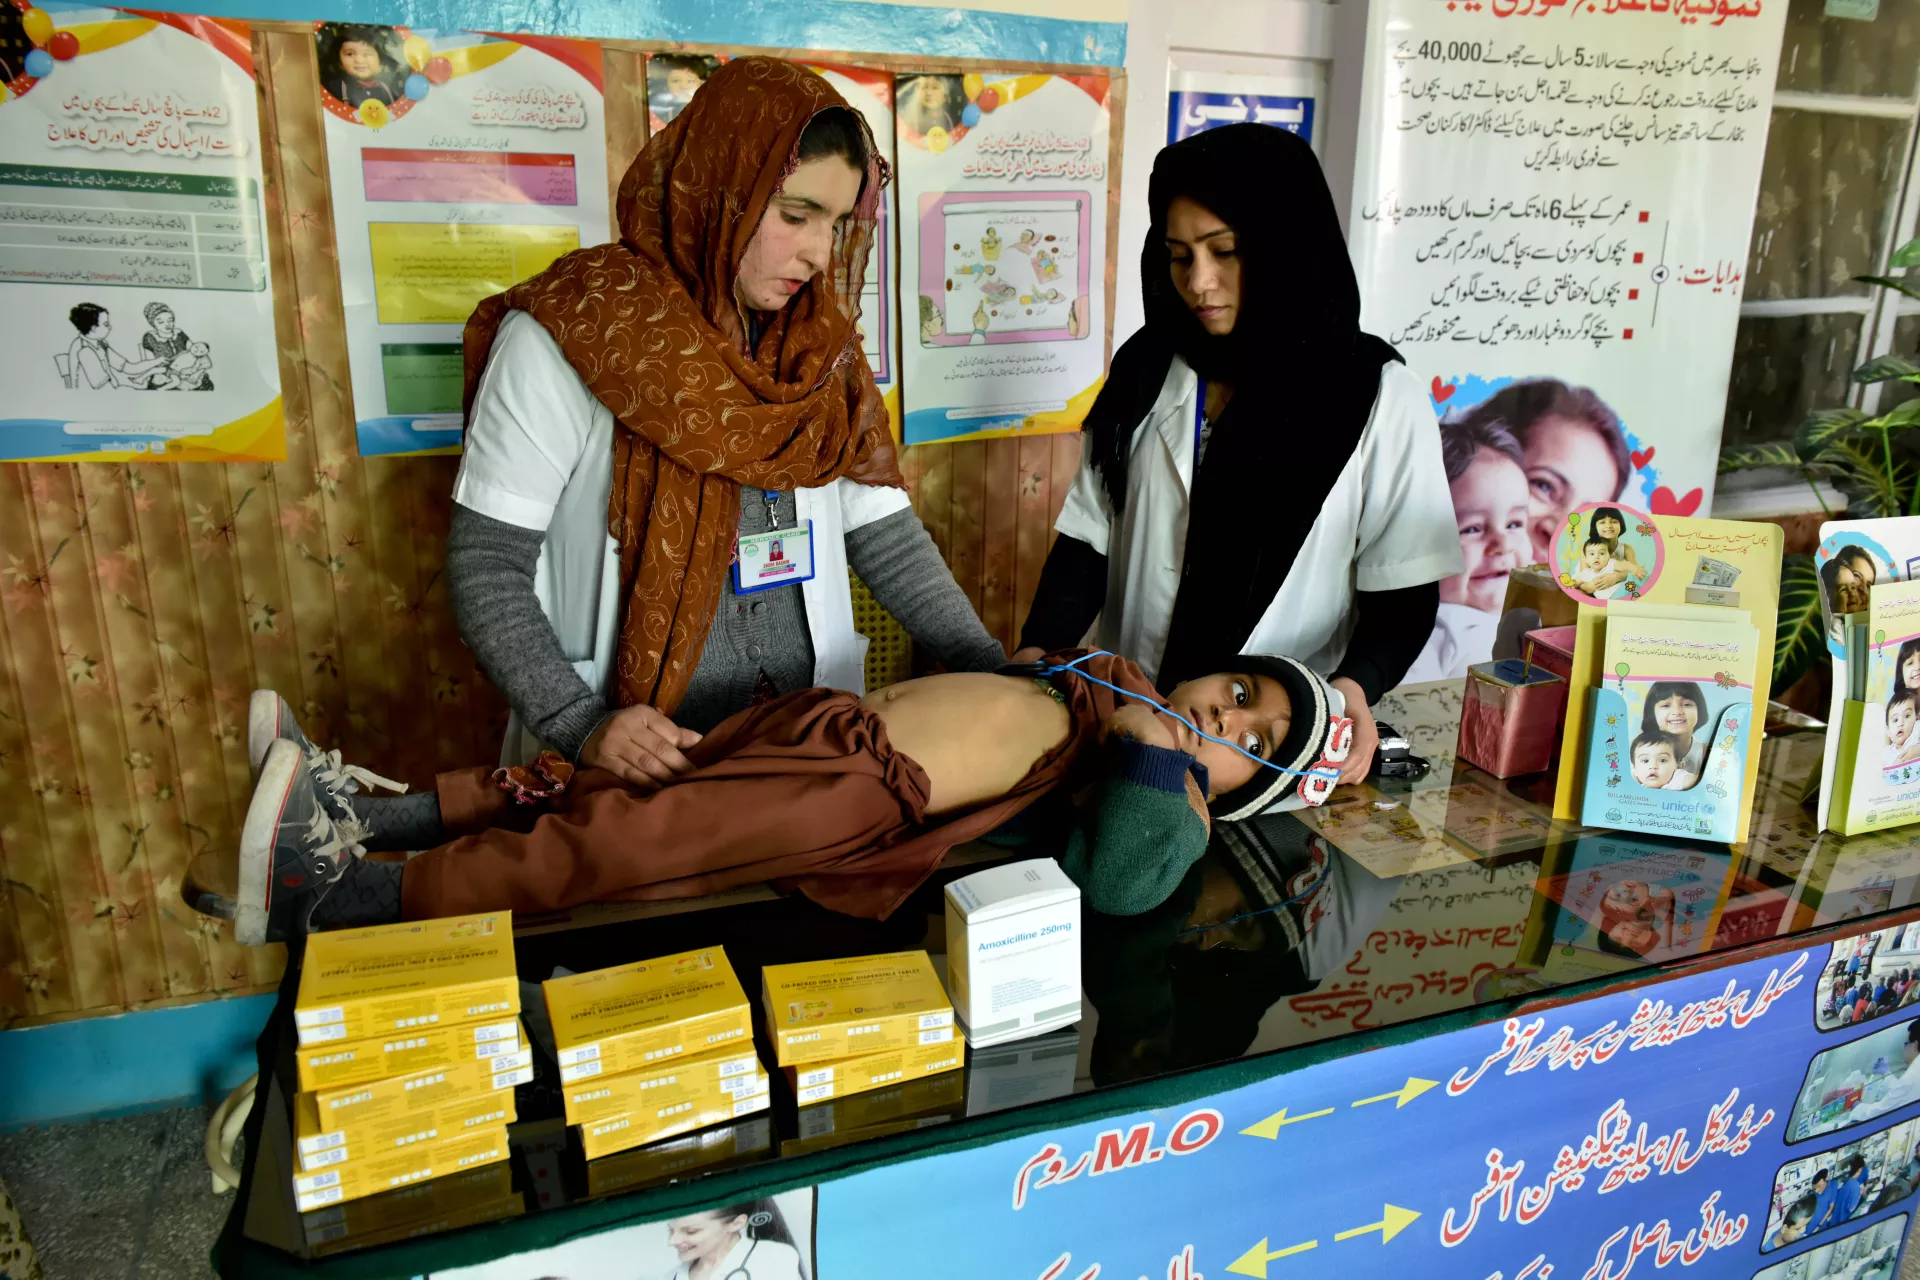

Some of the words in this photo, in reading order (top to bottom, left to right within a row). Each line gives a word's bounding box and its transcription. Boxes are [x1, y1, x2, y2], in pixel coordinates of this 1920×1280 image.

[1418, 40, 1482, 64] 40,000
[1482, 38, 1526, 68] چھوٹے
[1521, 54, 1544, 65] سے
[1545, 44, 1572, 69] سال
[1574, 47, 1586, 67] 5
[1584, 52, 1617, 69] سالانہ
[1655, 46, 1674, 73] کی
[1615, 59, 1636, 69] سے
[1636, 60, 1655, 75] وجہ
[1666, 51, 1696, 77] نمونیہ
[1692, 55, 1714, 75] میں
[1709, 56, 1733, 77] بھر
[1730, 58, 1762, 80] پنجاب
[1412, 77, 1441, 102] بچوں
[1474, 80, 1505, 104] جاتے
[1506, 88, 1523, 102] بن
[1564, 92, 1584, 104] سے
[1603, 81, 1621, 107] کی
[1615, 84, 1651, 107] کرنے
[1651, 88, 1680, 109] رجوع
[1680, 92, 1714, 109] بروقت
[63, 95, 79, 110] میں
[83, 96, 104, 114] بچوں
[104, 96, 120, 111] کے
[123, 97, 139, 112] تک
[140, 96, 161, 115] سال
[164, 95, 182, 120] پانچ
[183, 108, 200, 117] سے
[1585, 94, 1602, 109] وجہ
[1736, 93, 1759, 112] علاج
[47, 124, 76, 141] علاج
[1397, 111, 1432, 131] صحت
[1515, 117, 1541, 137] علاج
[1543, 117, 1565, 138] میں
[1565, 122, 1605, 137] صورت
[1602, 113, 1620, 140] کی
[1614, 114, 1634, 147] چلنے
[1635, 114, 1667, 141] سانس
[1680, 122, 1708, 140] ساتھ
[1707, 120, 1725, 141] کے
[79, 125, 88, 141] کا
[88, 128, 107, 144] اس
[110, 130, 124, 143] اور
[126, 120, 161, 147] تشخیص
[157, 125, 172, 148] کی
[1664, 123, 1682, 144] تیز
[1727, 127, 1746, 142] بخار
[1524, 141, 1559, 171] کریں
[1550, 149, 1574, 171] رابطہ
[1573, 145, 1599, 169] فوری
[1597, 156, 1619, 167] سے
[1404, 204, 1438, 218] دودھ
[1439, 195, 1454, 217] کا
[1449, 199, 1471, 221] ماں
[1472, 197, 1514, 222] صرف
[1510, 194, 1540, 218] تک
[1562, 192, 1589, 228] پہلے
[1590, 194, 1613, 219] کے
[1609, 200, 1632, 226] عمر
[1416, 227, 1458, 262] رکھیں
[1453, 230, 1483, 265] گرم
[1472, 241, 1490, 260] اور
[1490, 232, 1531, 269] بچائیں
[1531, 248, 1556, 259] سے
[1557, 239, 1591, 264] سردی
[1585, 233, 1606, 260] کو
[1595, 238, 1627, 266] بچوں
[1431, 271, 1484, 308] لگوائیں
[1474, 280, 1518, 304] بروقت
[1518, 275, 1541, 308] ٹیکے
[1545, 272, 1584, 305] حفاظتی
[1580, 275, 1601, 302] کو
[1590, 281, 1622, 308] بچوں
[1390, 311, 1432, 345] رکھیں
[1424, 315, 1461, 341] محفوظ
[1451, 329, 1477, 341] سے
[1520, 324, 1539, 340] اور
[1581, 314, 1602, 340] کو
[1591, 318, 1614, 348] بچے
[1752, 532, 1769, 546] بچوں
[1662, 801, 1700, 813] unicef
[978, 929, 1038, 952] Amoxicilline
[1040, 921, 1073, 937] 250mg
[1731, 952, 1809, 1029] سکول
[1446, 1017, 1545, 1096] آفس
[1089, 1109, 1224, 1177] M.O
[1516, 1098, 1632, 1225] ٹیکنیشن
[1012, 1143, 1095, 1210] روم
[1441, 1147, 1525, 1248] آفس
[1680, 1190, 1749, 1266] دوائی
